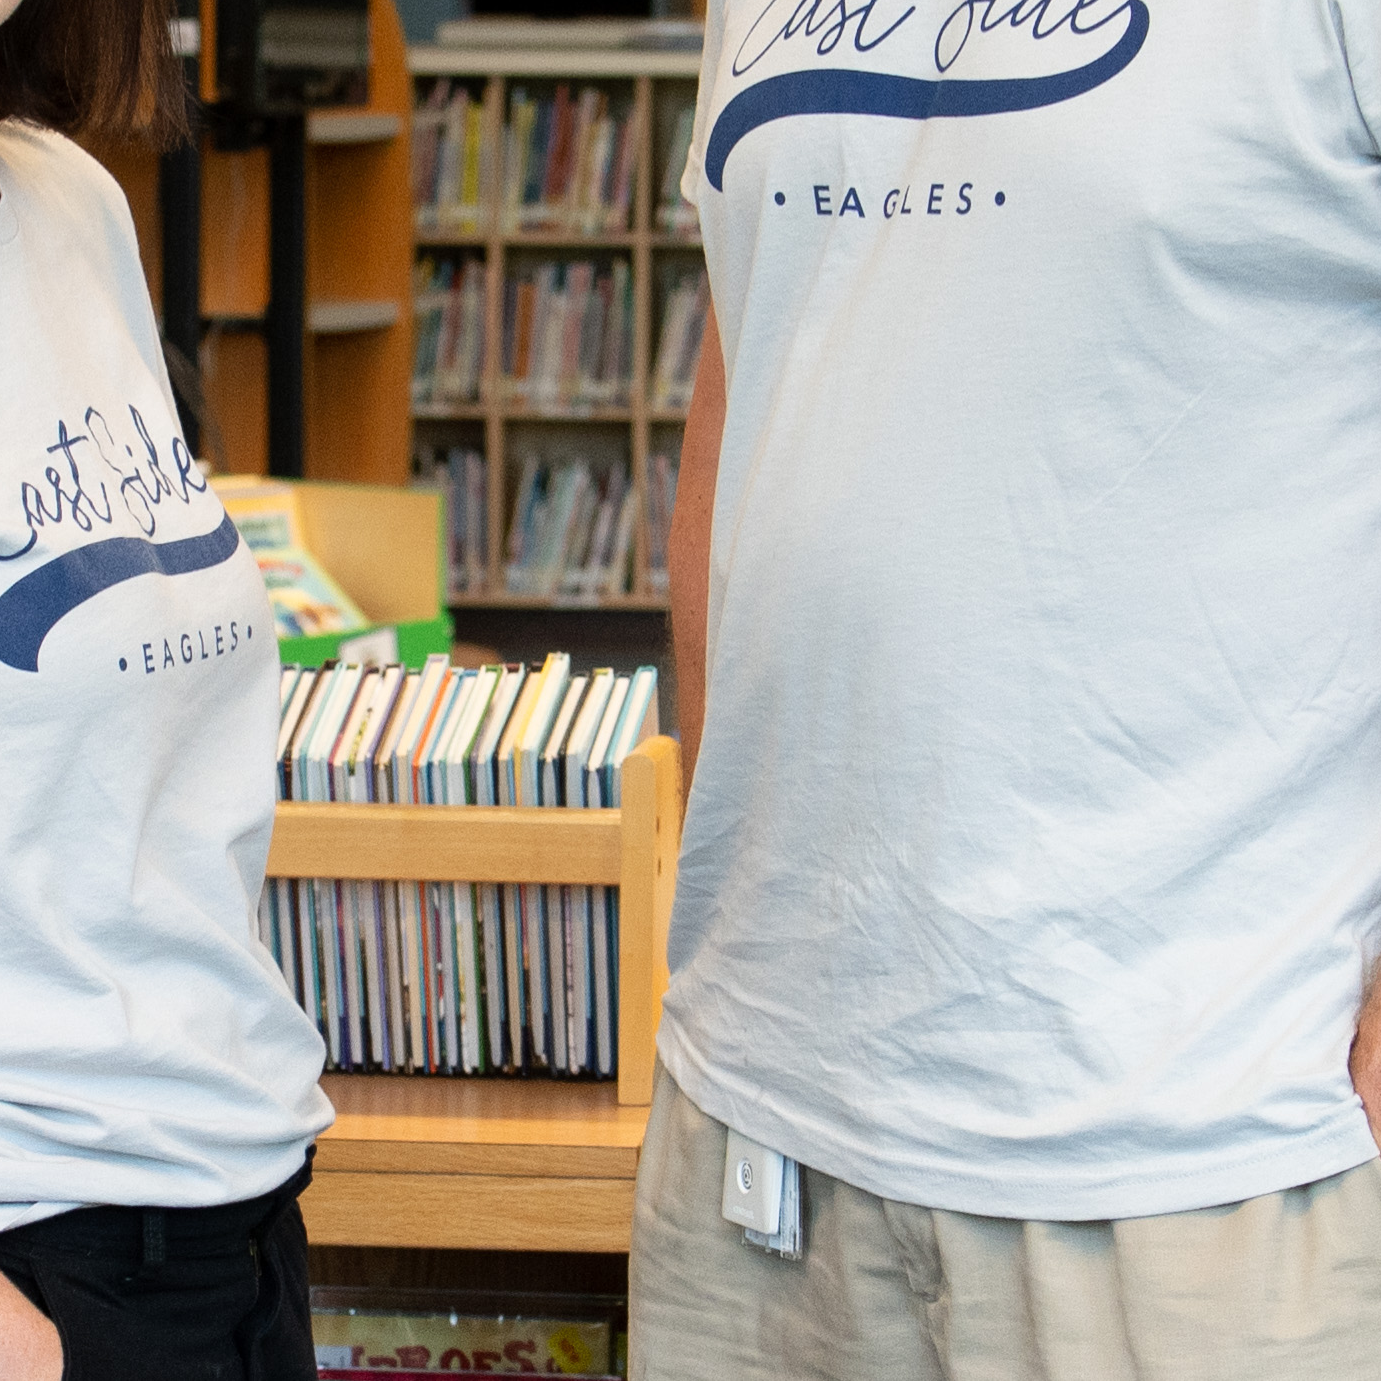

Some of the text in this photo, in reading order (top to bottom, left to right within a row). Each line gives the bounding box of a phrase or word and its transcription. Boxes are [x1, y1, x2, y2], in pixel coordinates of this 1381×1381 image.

[812, 182, 974, 220] EAGLES
[84, 403, 207, 538] Side
[142, 620, 240, 675] EAGLES
